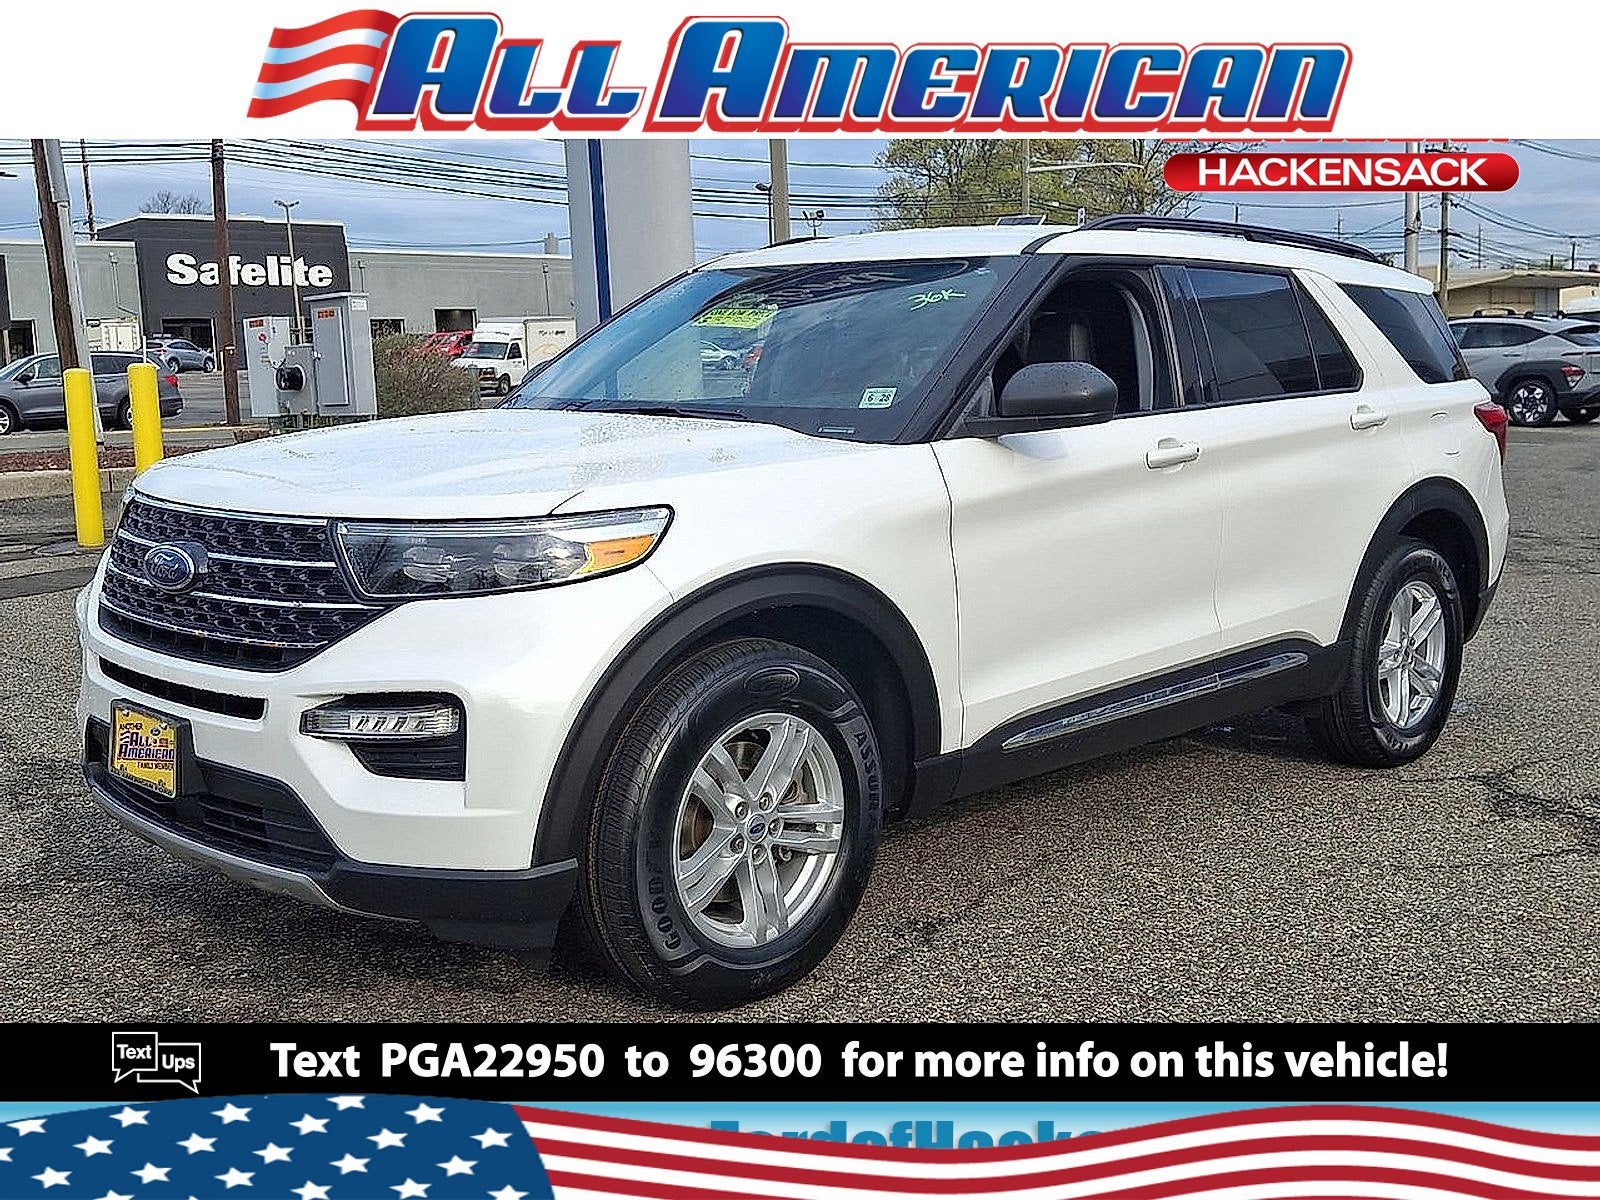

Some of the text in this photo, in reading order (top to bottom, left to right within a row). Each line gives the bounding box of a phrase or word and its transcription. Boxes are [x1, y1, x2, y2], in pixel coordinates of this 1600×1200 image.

[166, 253, 333, 287] Safelite
[129, 731, 153, 748] ALL
[118, 743, 175, 760] AMERICAN
